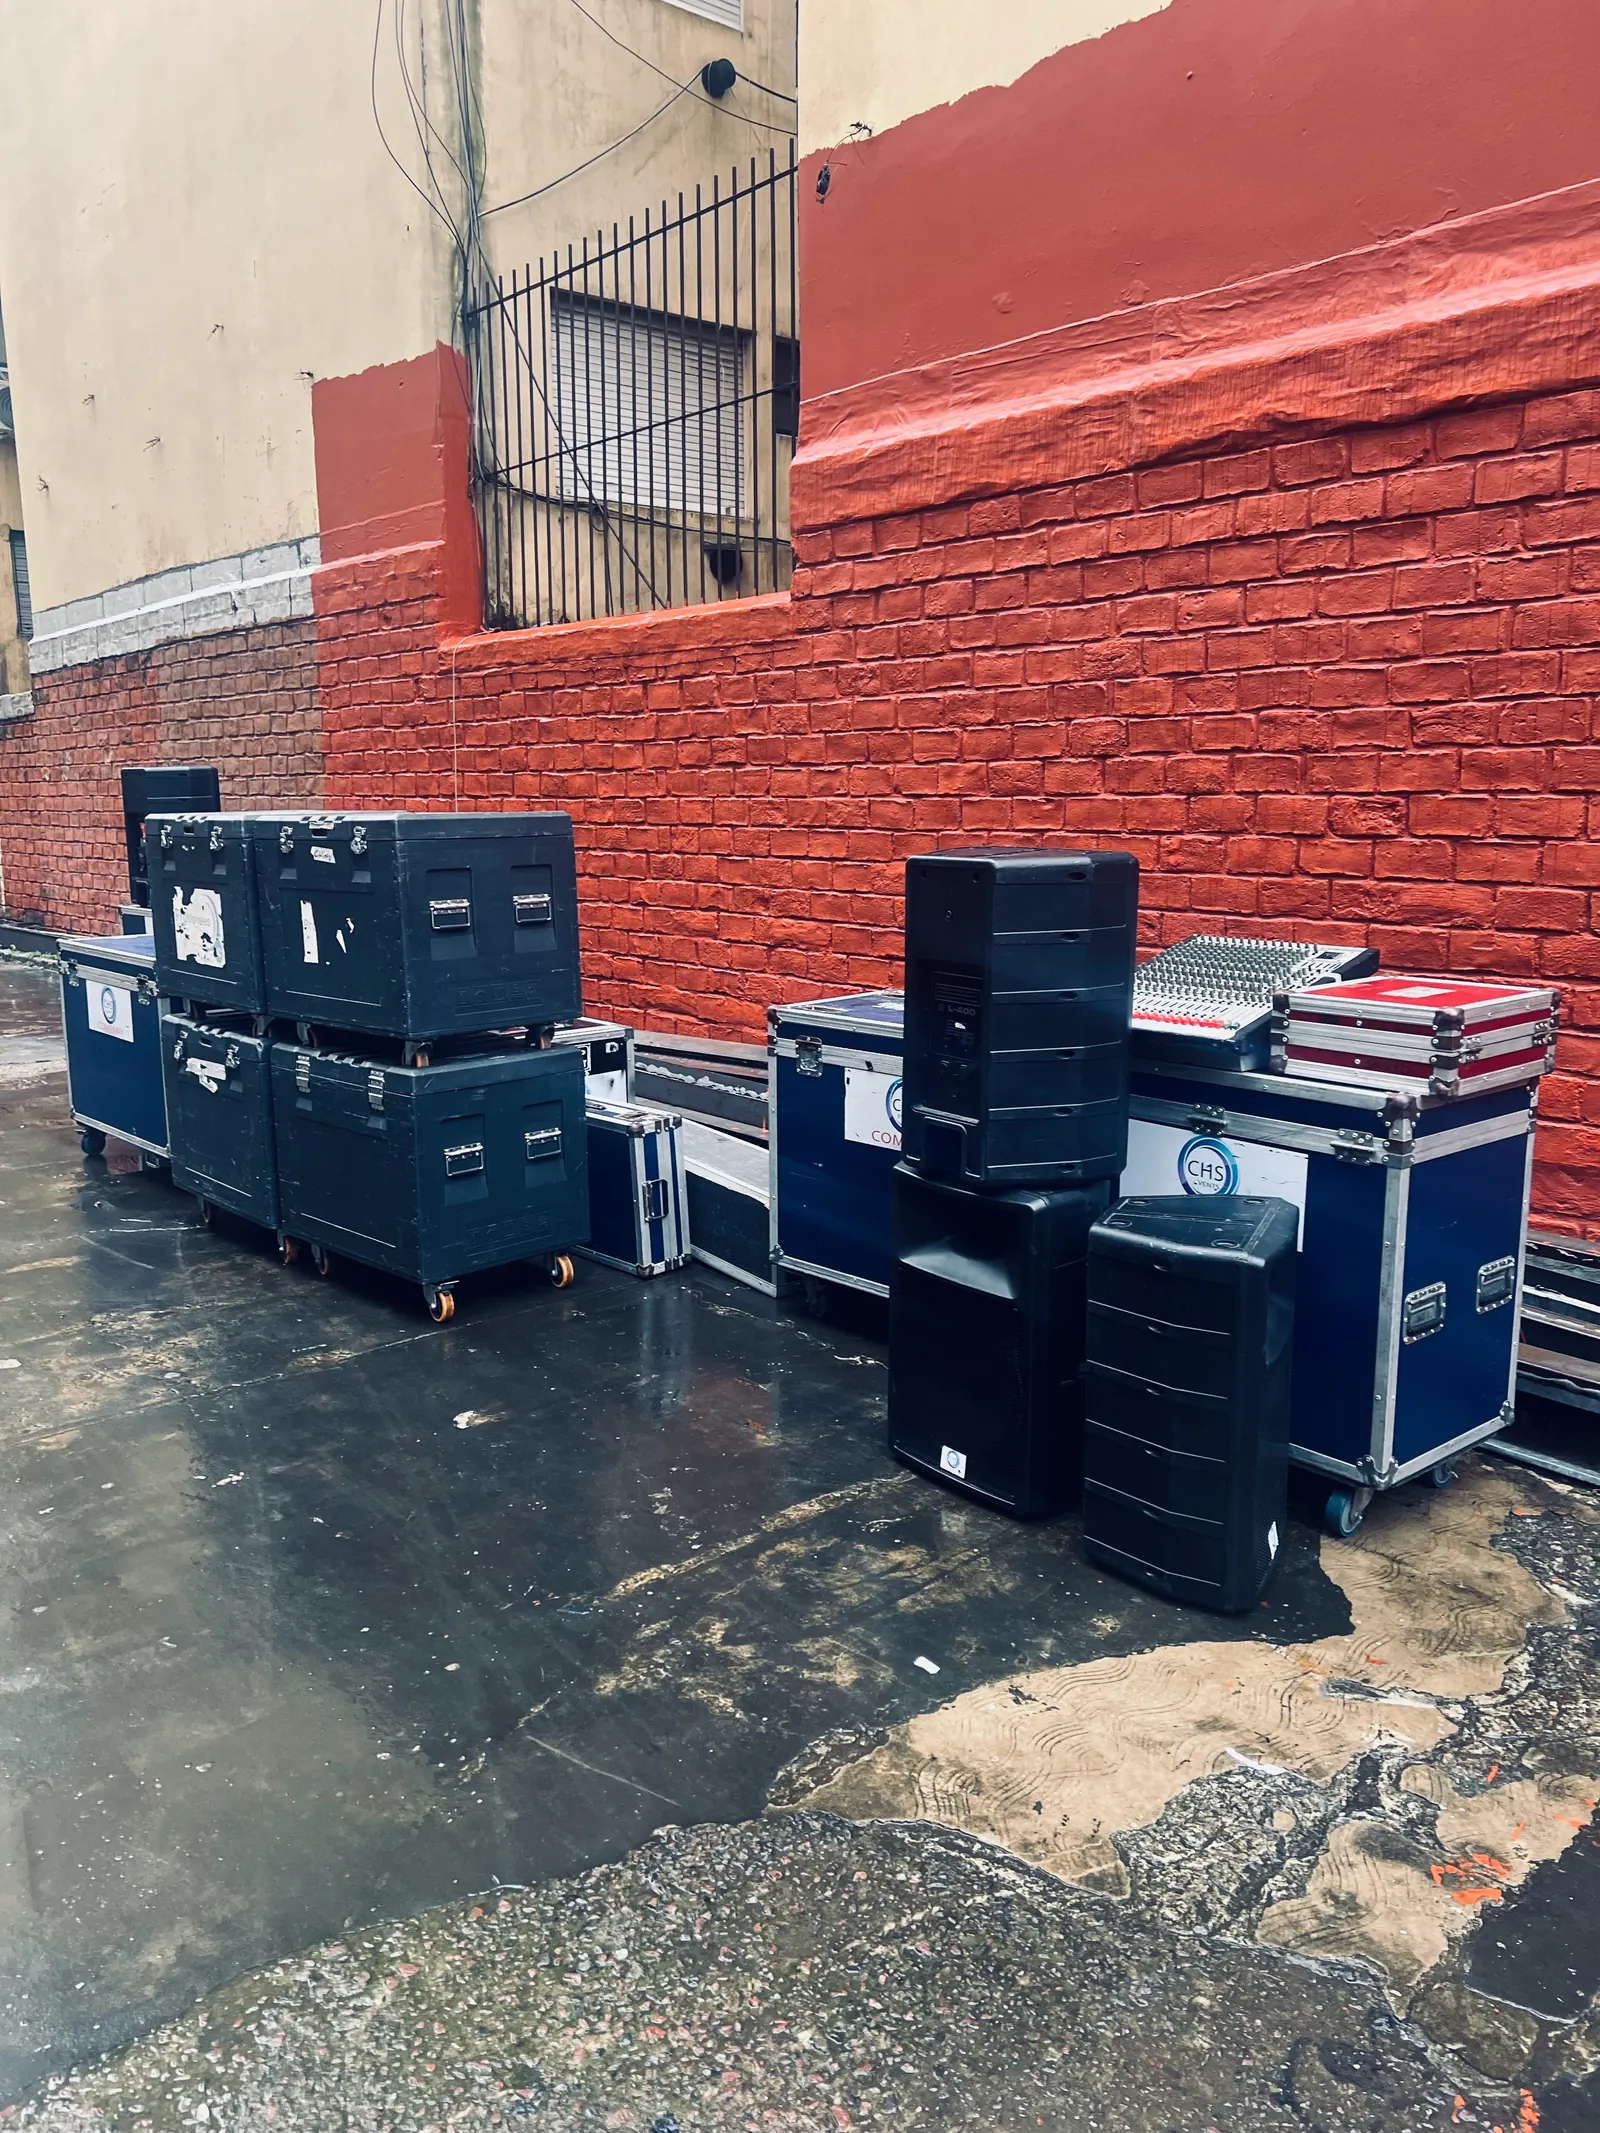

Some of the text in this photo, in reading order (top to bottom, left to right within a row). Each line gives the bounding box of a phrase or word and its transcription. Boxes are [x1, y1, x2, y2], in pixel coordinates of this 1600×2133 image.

[947, 1003, 976, 1017] L-400
[1187, 1160, 1224, 1182] CHS
[1194, 1180, 1220, 1191] VENTS
